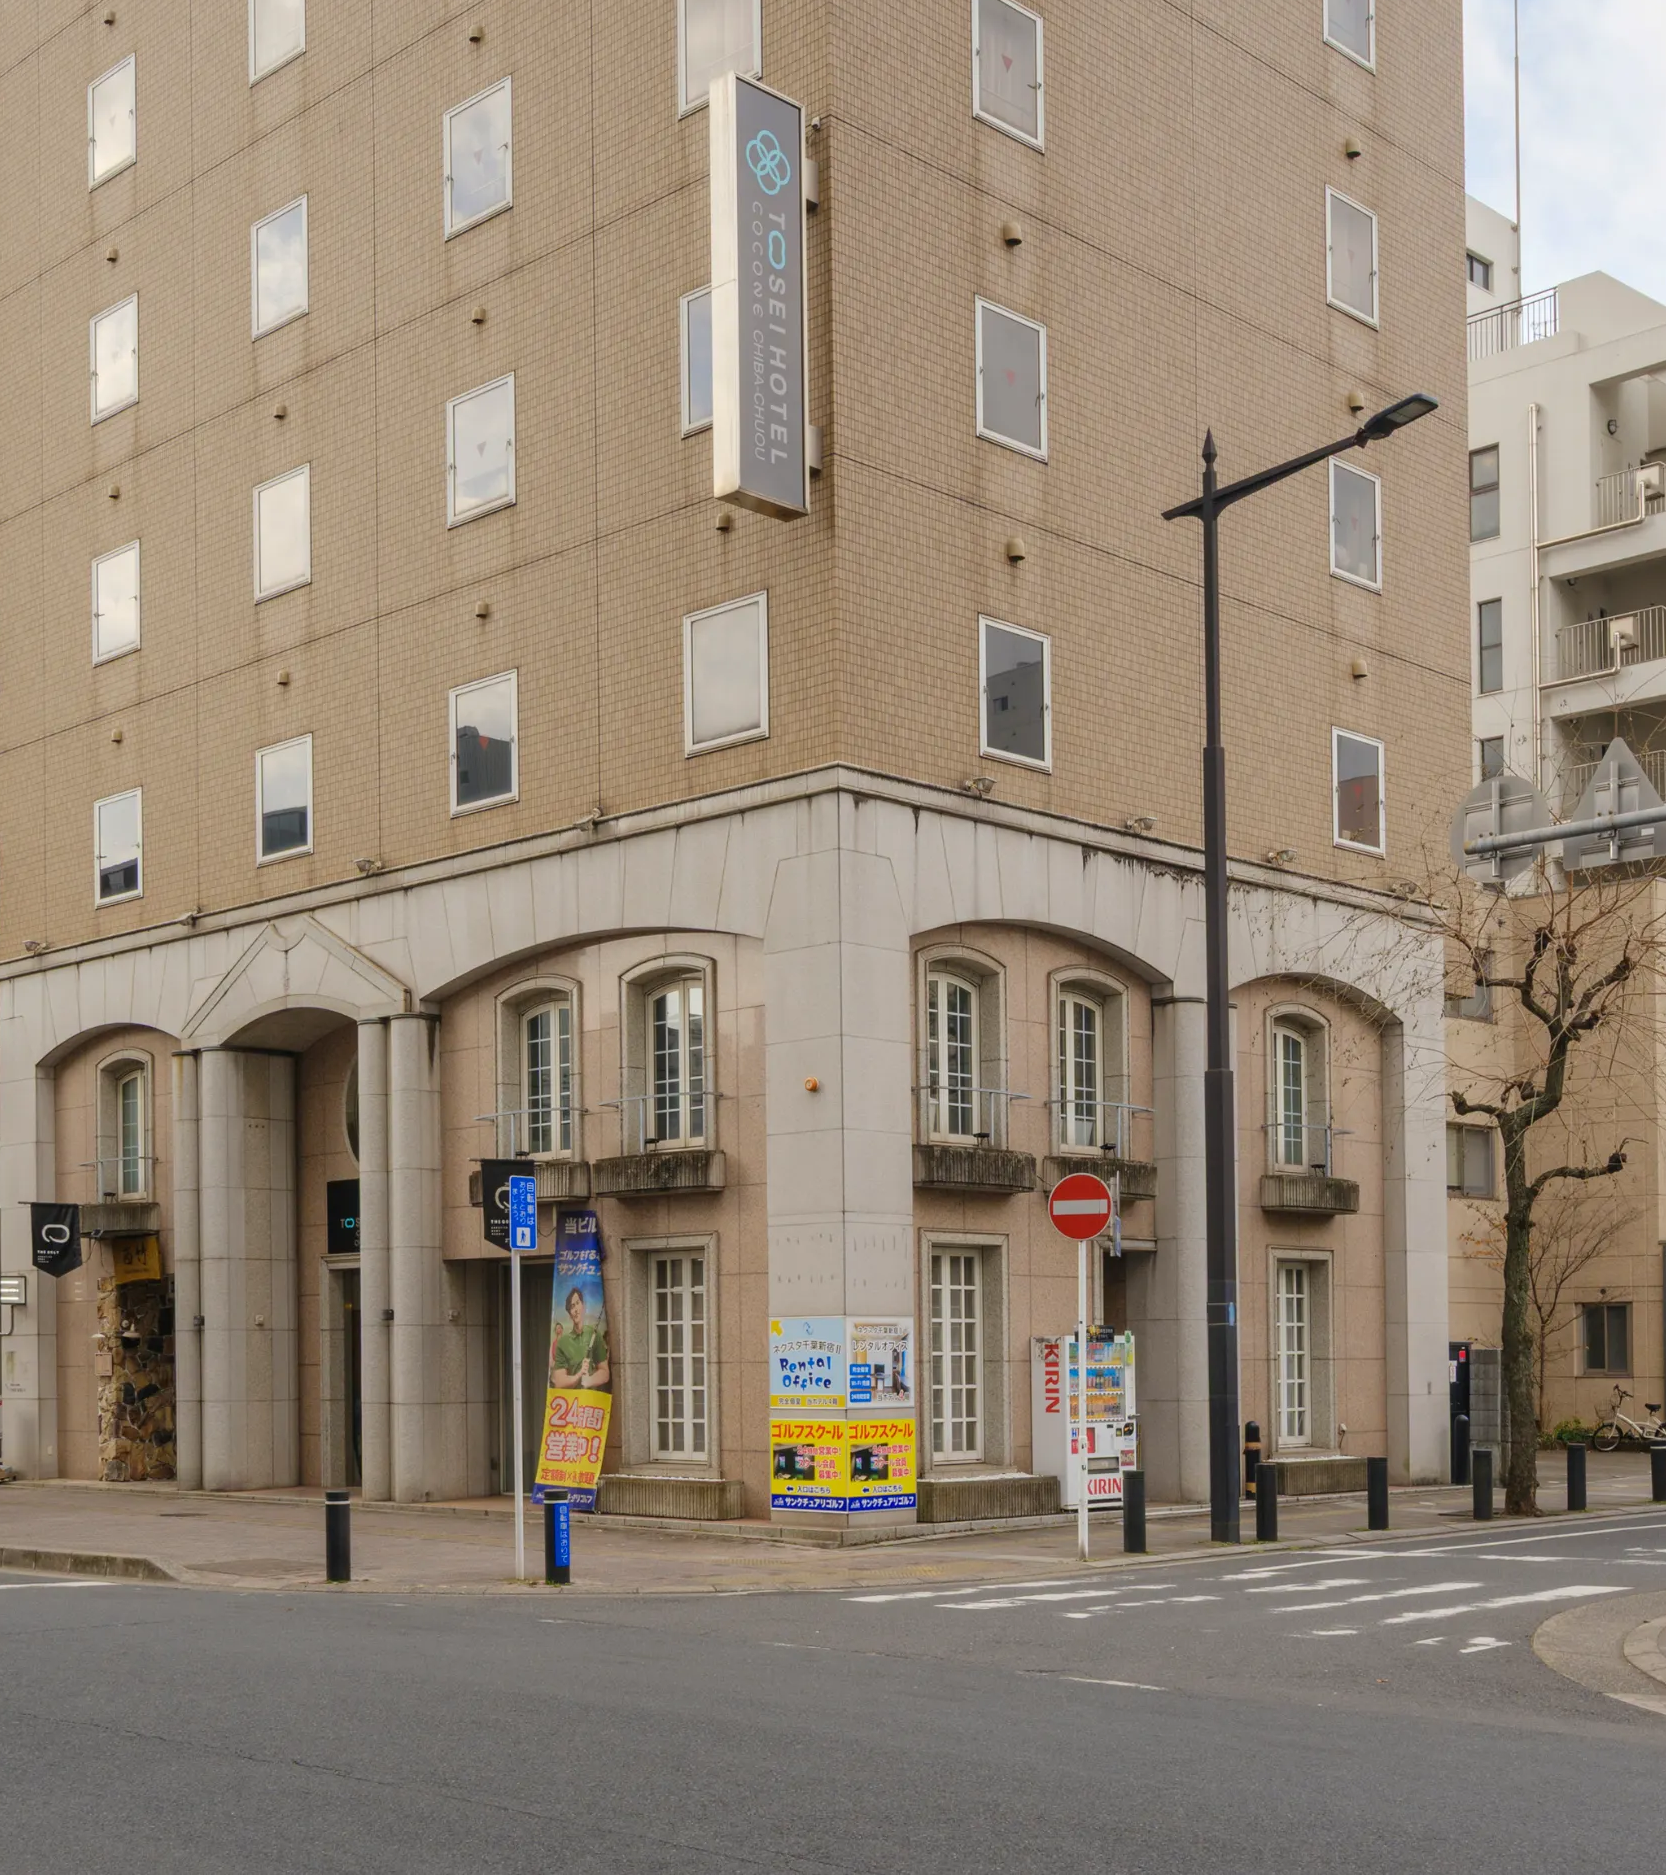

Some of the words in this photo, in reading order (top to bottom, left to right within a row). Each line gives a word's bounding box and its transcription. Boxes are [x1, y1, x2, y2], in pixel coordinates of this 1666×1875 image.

[768, 211, 786, 335] TOSEI
[752, 329, 766, 461] CHIBA-CHUOU
[769, 344, 788, 465] HOTEL
[527, 1182, 535, 1225] 自転車は
[779, 1356, 832, 1373] Rental
[782, 1372, 832, 1391] Office
[1044, 1344, 1061, 1413] KIRIN
[772, 1423, 843, 1440] ゴルフスクール
[849, 1423, 913, 1440] ゴルフスクール
[797, 1486, 831, 1494] 入口はこちら
[872, 1485, 903, 1493] 入口はこちら
[785, 1497, 844, 1509] サンクチュアリゴルフ
[861, 1496, 914, 1508] サンクチュアリゴルフ
